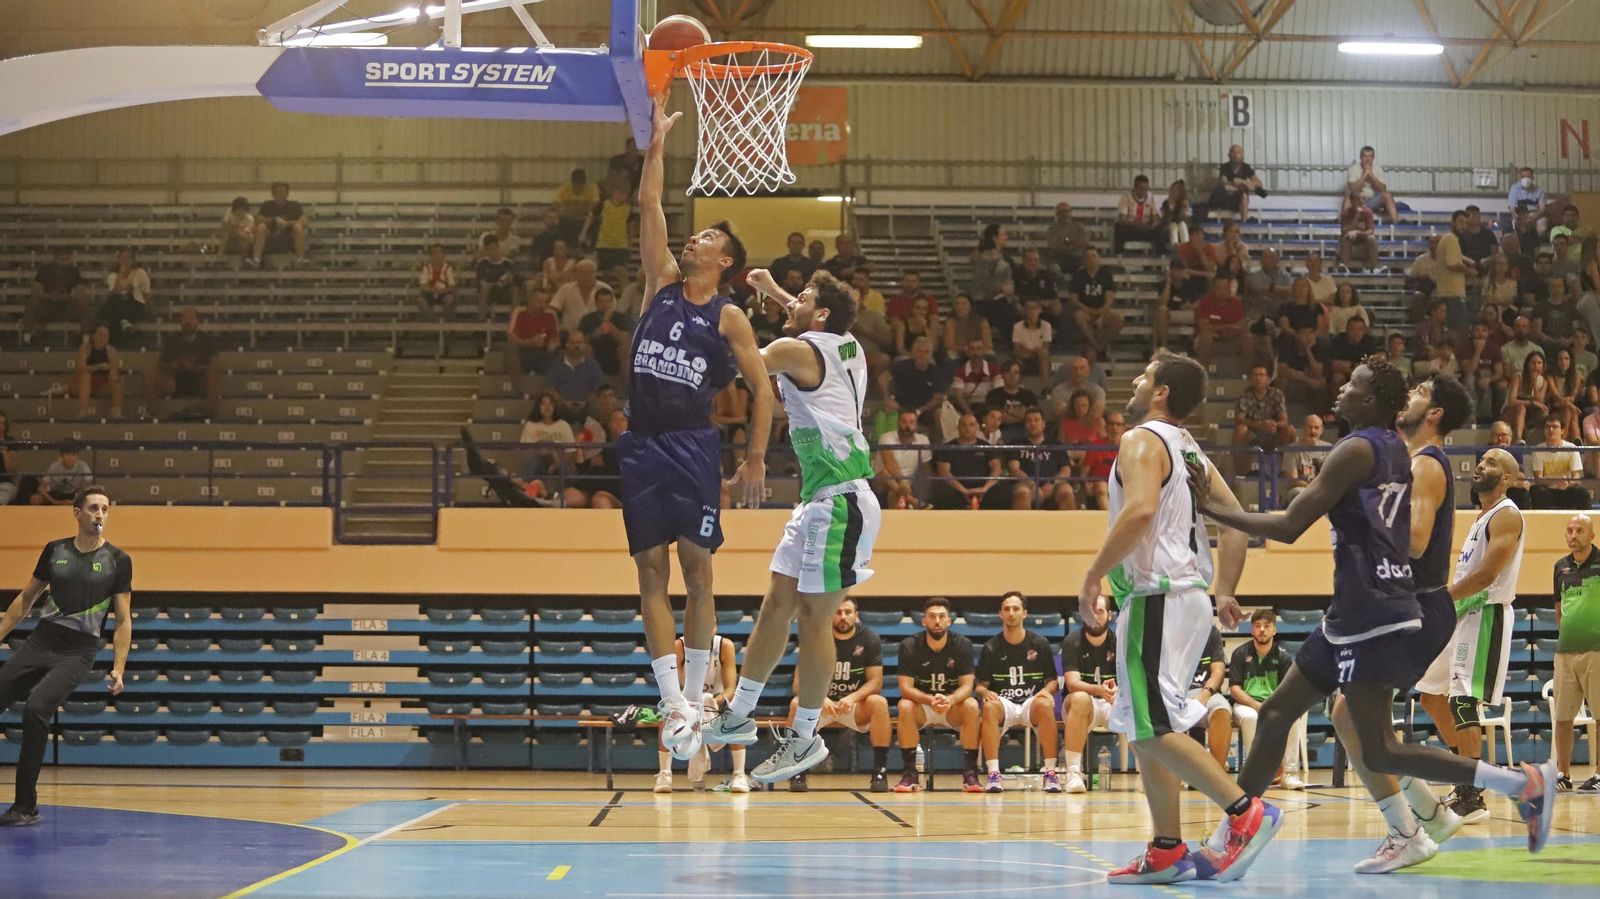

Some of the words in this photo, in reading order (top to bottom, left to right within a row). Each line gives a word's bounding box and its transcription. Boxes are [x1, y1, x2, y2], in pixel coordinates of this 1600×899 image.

[365, 62, 450, 81] SPORT
[451, 63, 557, 87] SYSTEM
[1232, 95, 1250, 127] B
[1560, 119, 1589, 159] N
[669, 321, 684, 341] 6
[637, 339, 707, 373] APOLO
[634, 353, 703, 386] BRANDING
[699, 515, 715, 537] 6
[353, 619, 377, 629] FILA
[380, 620, 386, 630] 5
[355, 650, 378, 660] FILA
[380, 651, 387, 661] 4
[930, 673, 946, 692] 12
[1009, 666, 1026, 686] 91
[351, 681, 375, 691] FILA
[378, 682, 385, 692] 3
[352, 712, 375, 722] FILA
[378, 713, 385, 722] 2
[351, 727, 375, 737] FILA
[379, 728, 384, 737] 1
